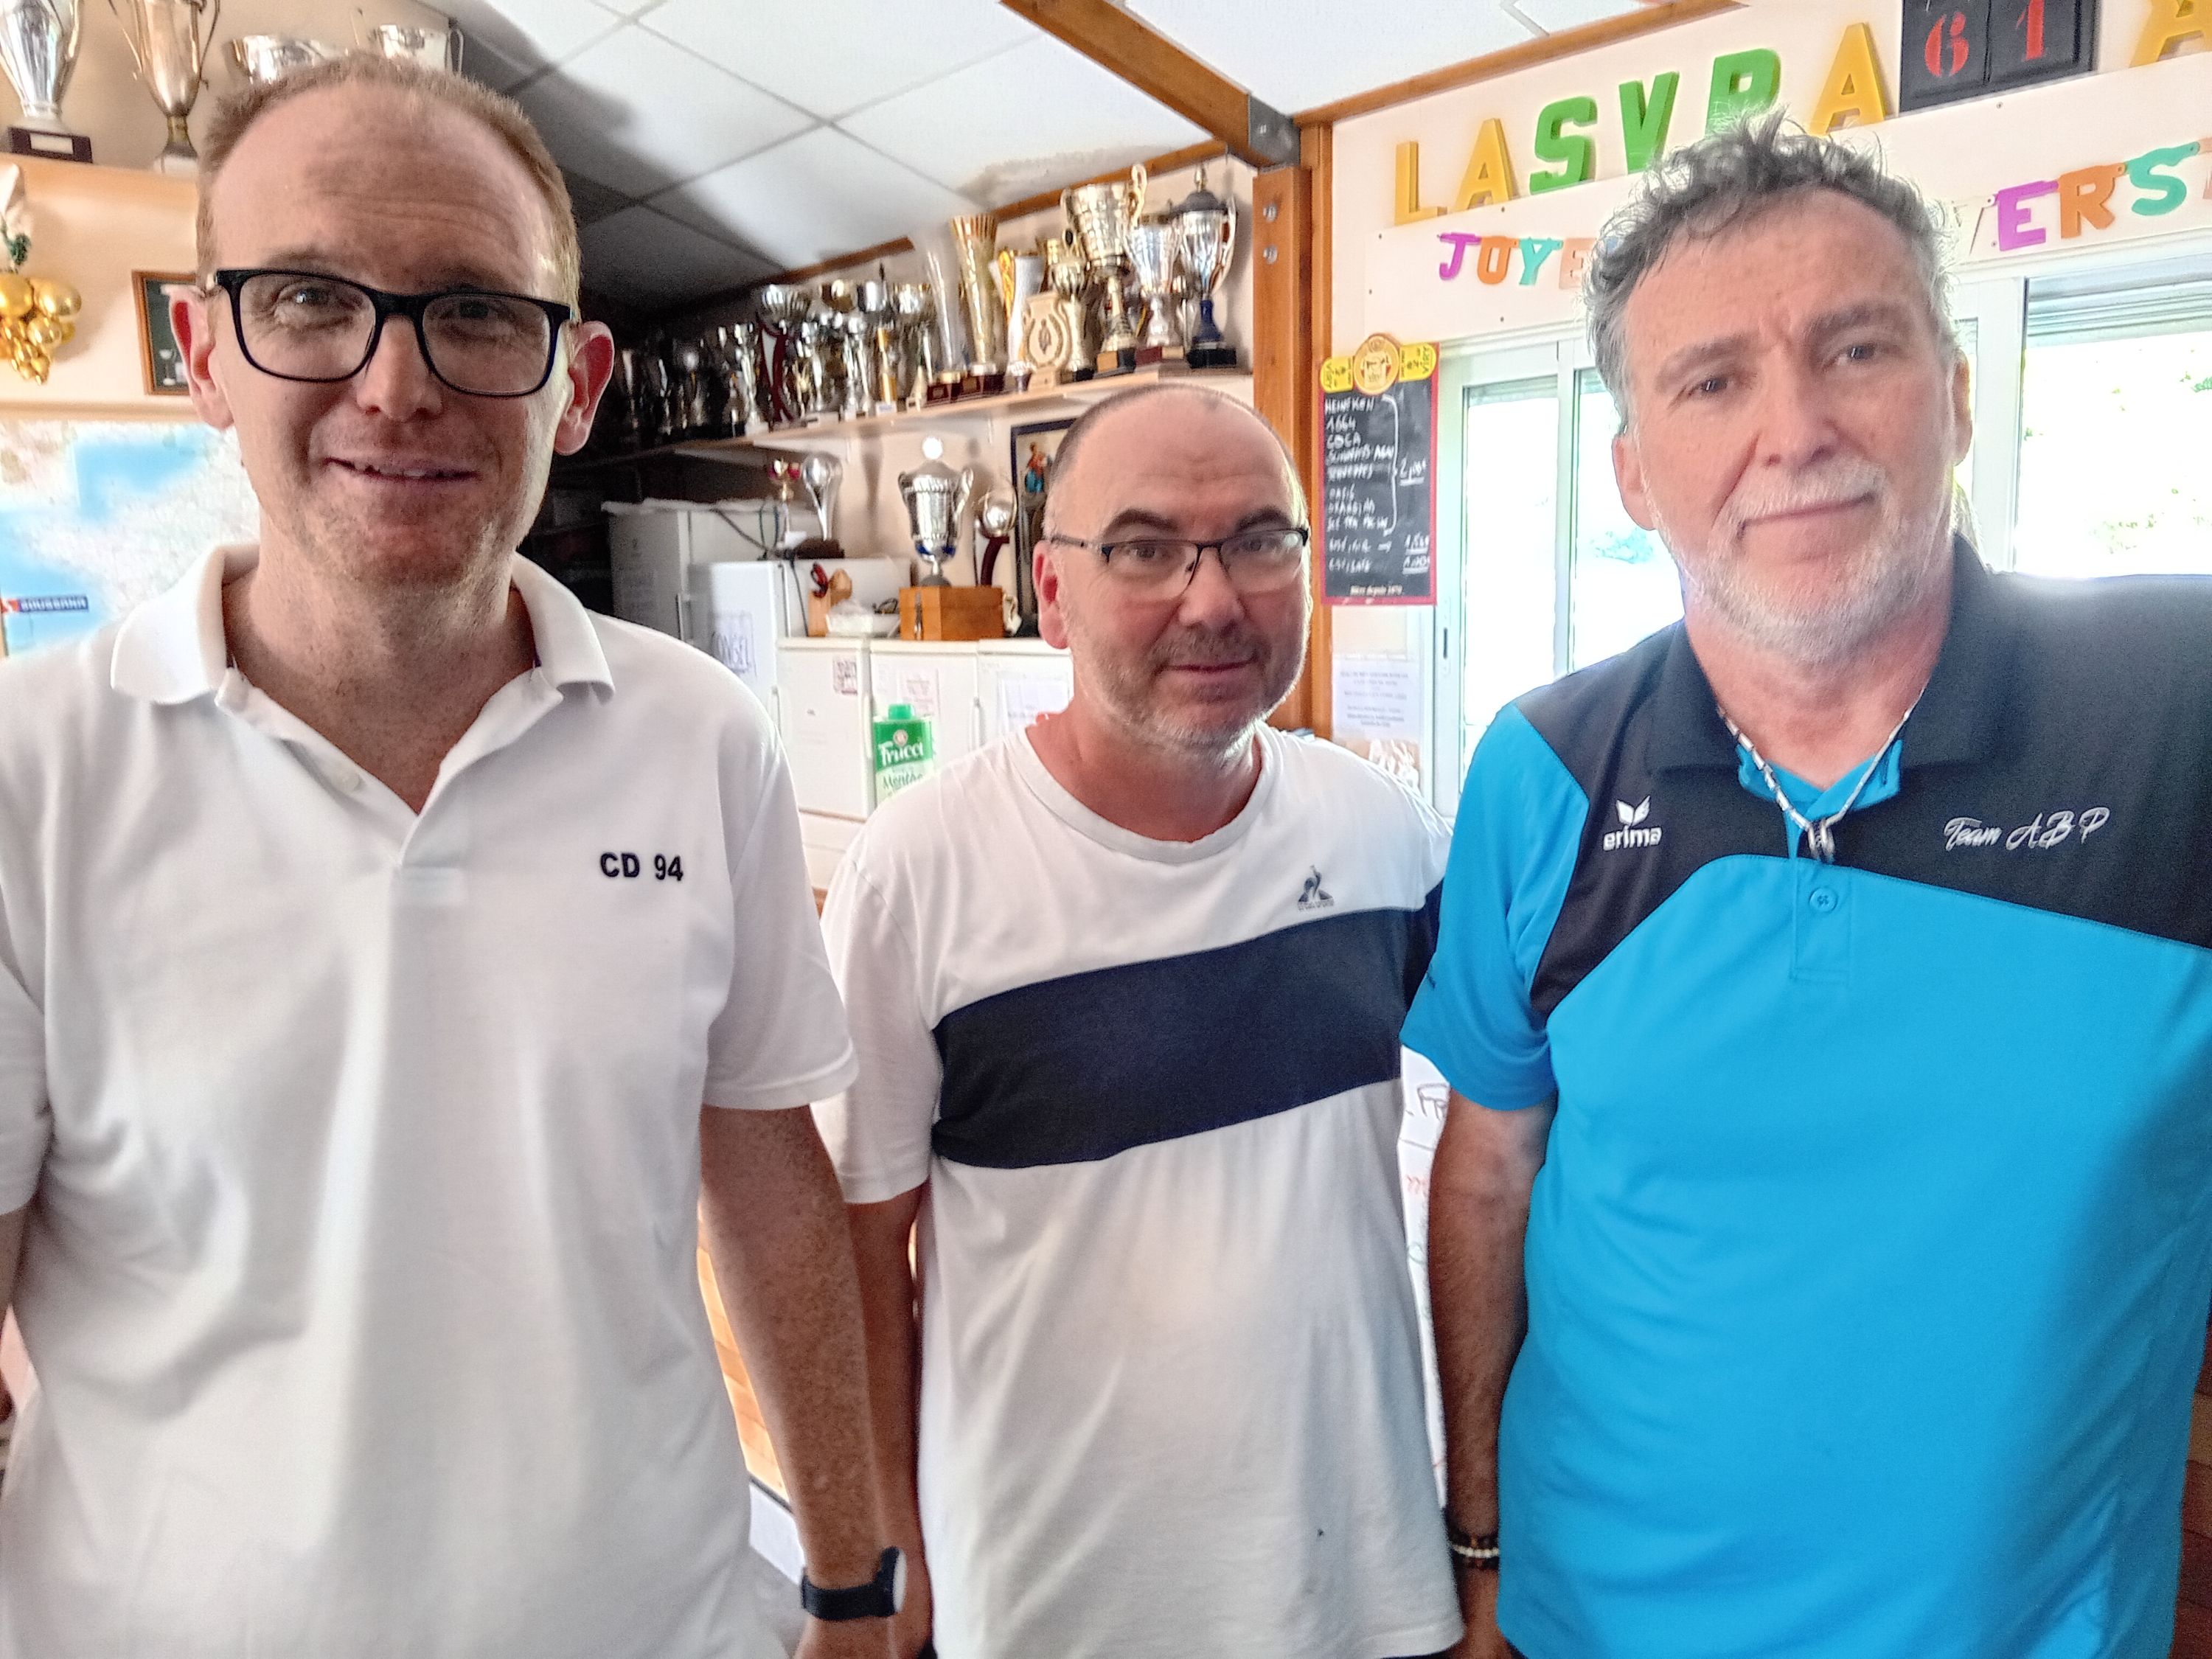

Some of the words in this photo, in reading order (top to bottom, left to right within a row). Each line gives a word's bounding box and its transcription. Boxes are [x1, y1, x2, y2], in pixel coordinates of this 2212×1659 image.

[1439, 232, 1601, 291] JOYE
[1603, 825, 1662, 851] erima
[1944, 817, 2003, 852] Team
[600, 852, 640, 877] CD
[654, 854, 684, 881] 94
